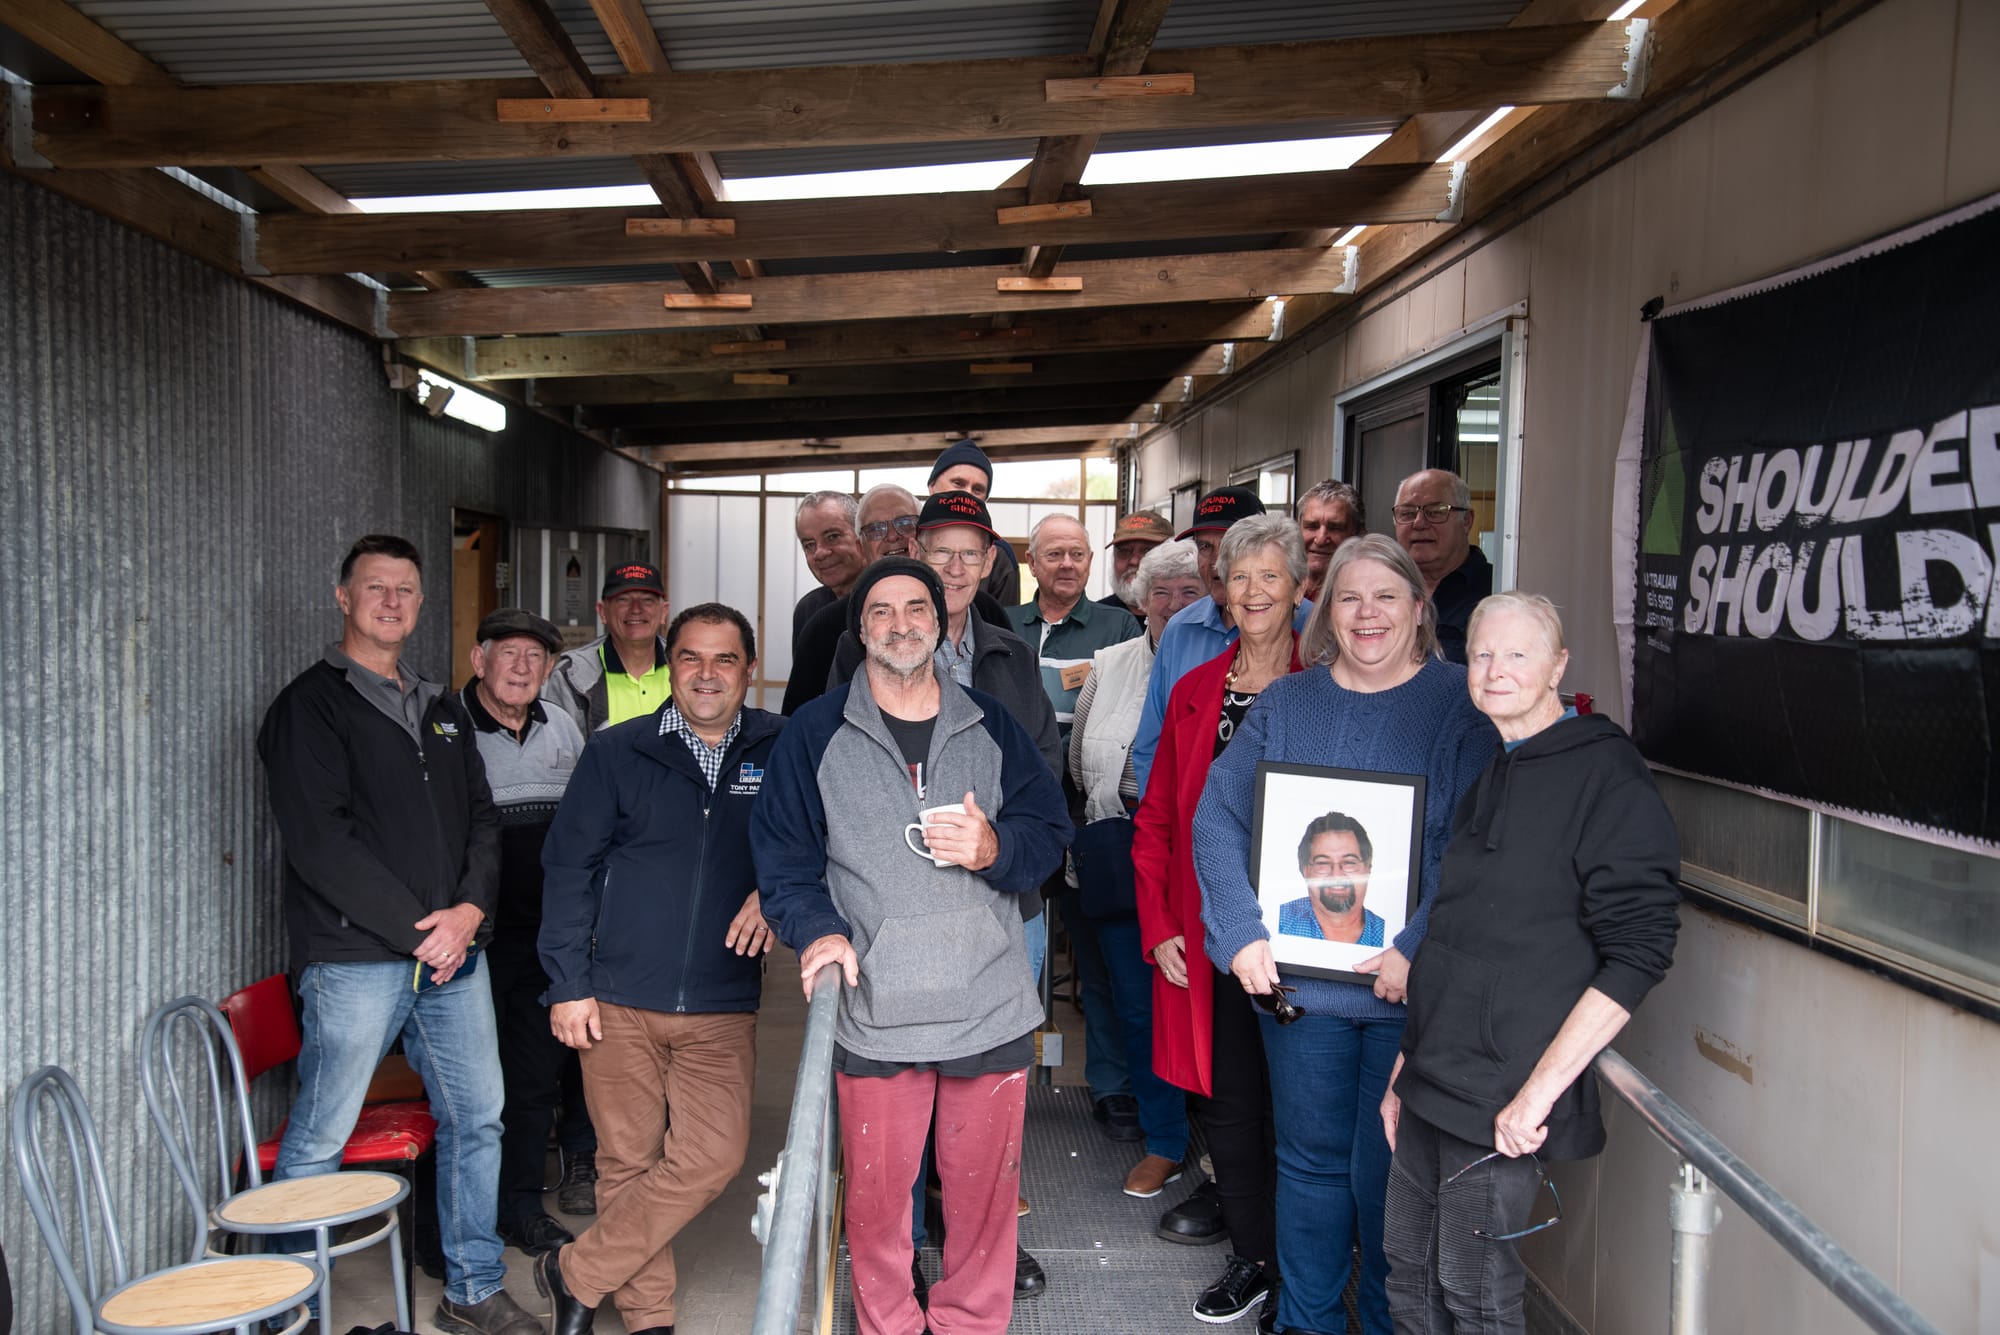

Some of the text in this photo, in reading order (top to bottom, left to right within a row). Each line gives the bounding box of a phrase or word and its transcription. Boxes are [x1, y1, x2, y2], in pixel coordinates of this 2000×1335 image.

[950, 504, 976, 515] SHED
[624, 571, 646, 579] SHED
[1658, 594, 1674, 611] SHED
